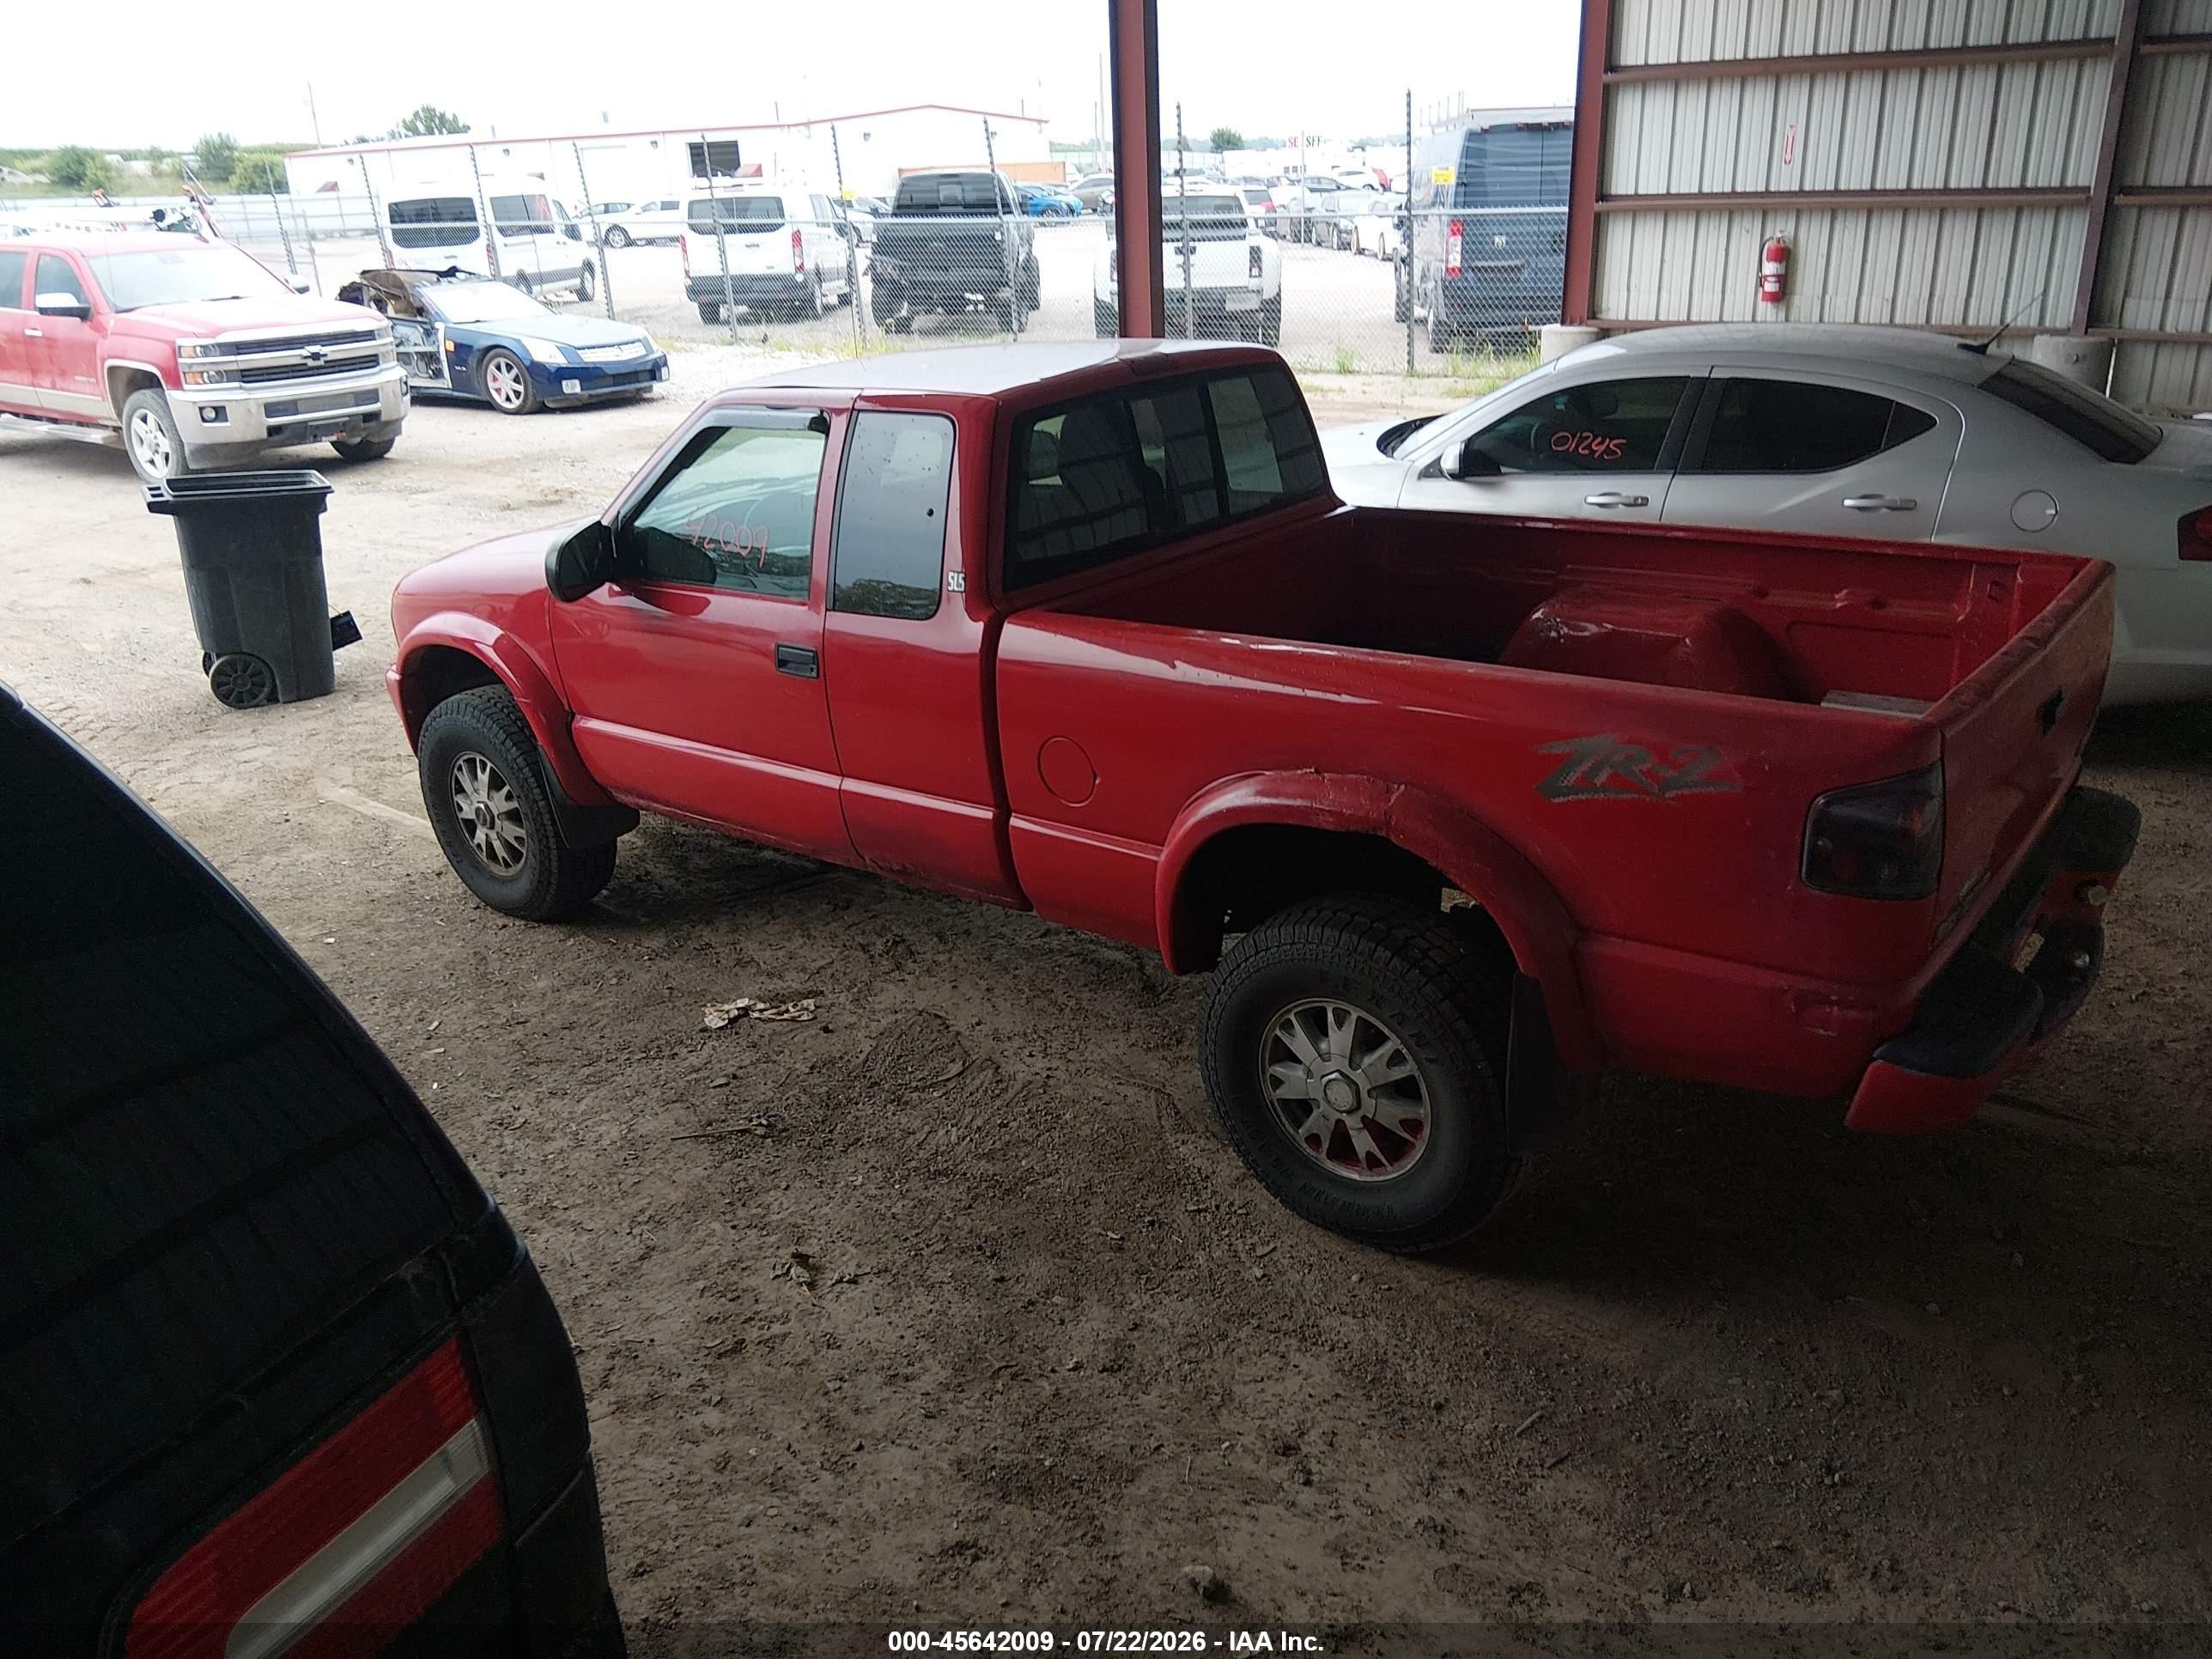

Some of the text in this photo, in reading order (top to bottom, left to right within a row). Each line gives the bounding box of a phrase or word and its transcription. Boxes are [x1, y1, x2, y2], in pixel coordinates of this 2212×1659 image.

[1551, 431, 1627, 460] 01245
[684, 505, 770, 568] 42009
[947, 571, 965, 592] SLS
